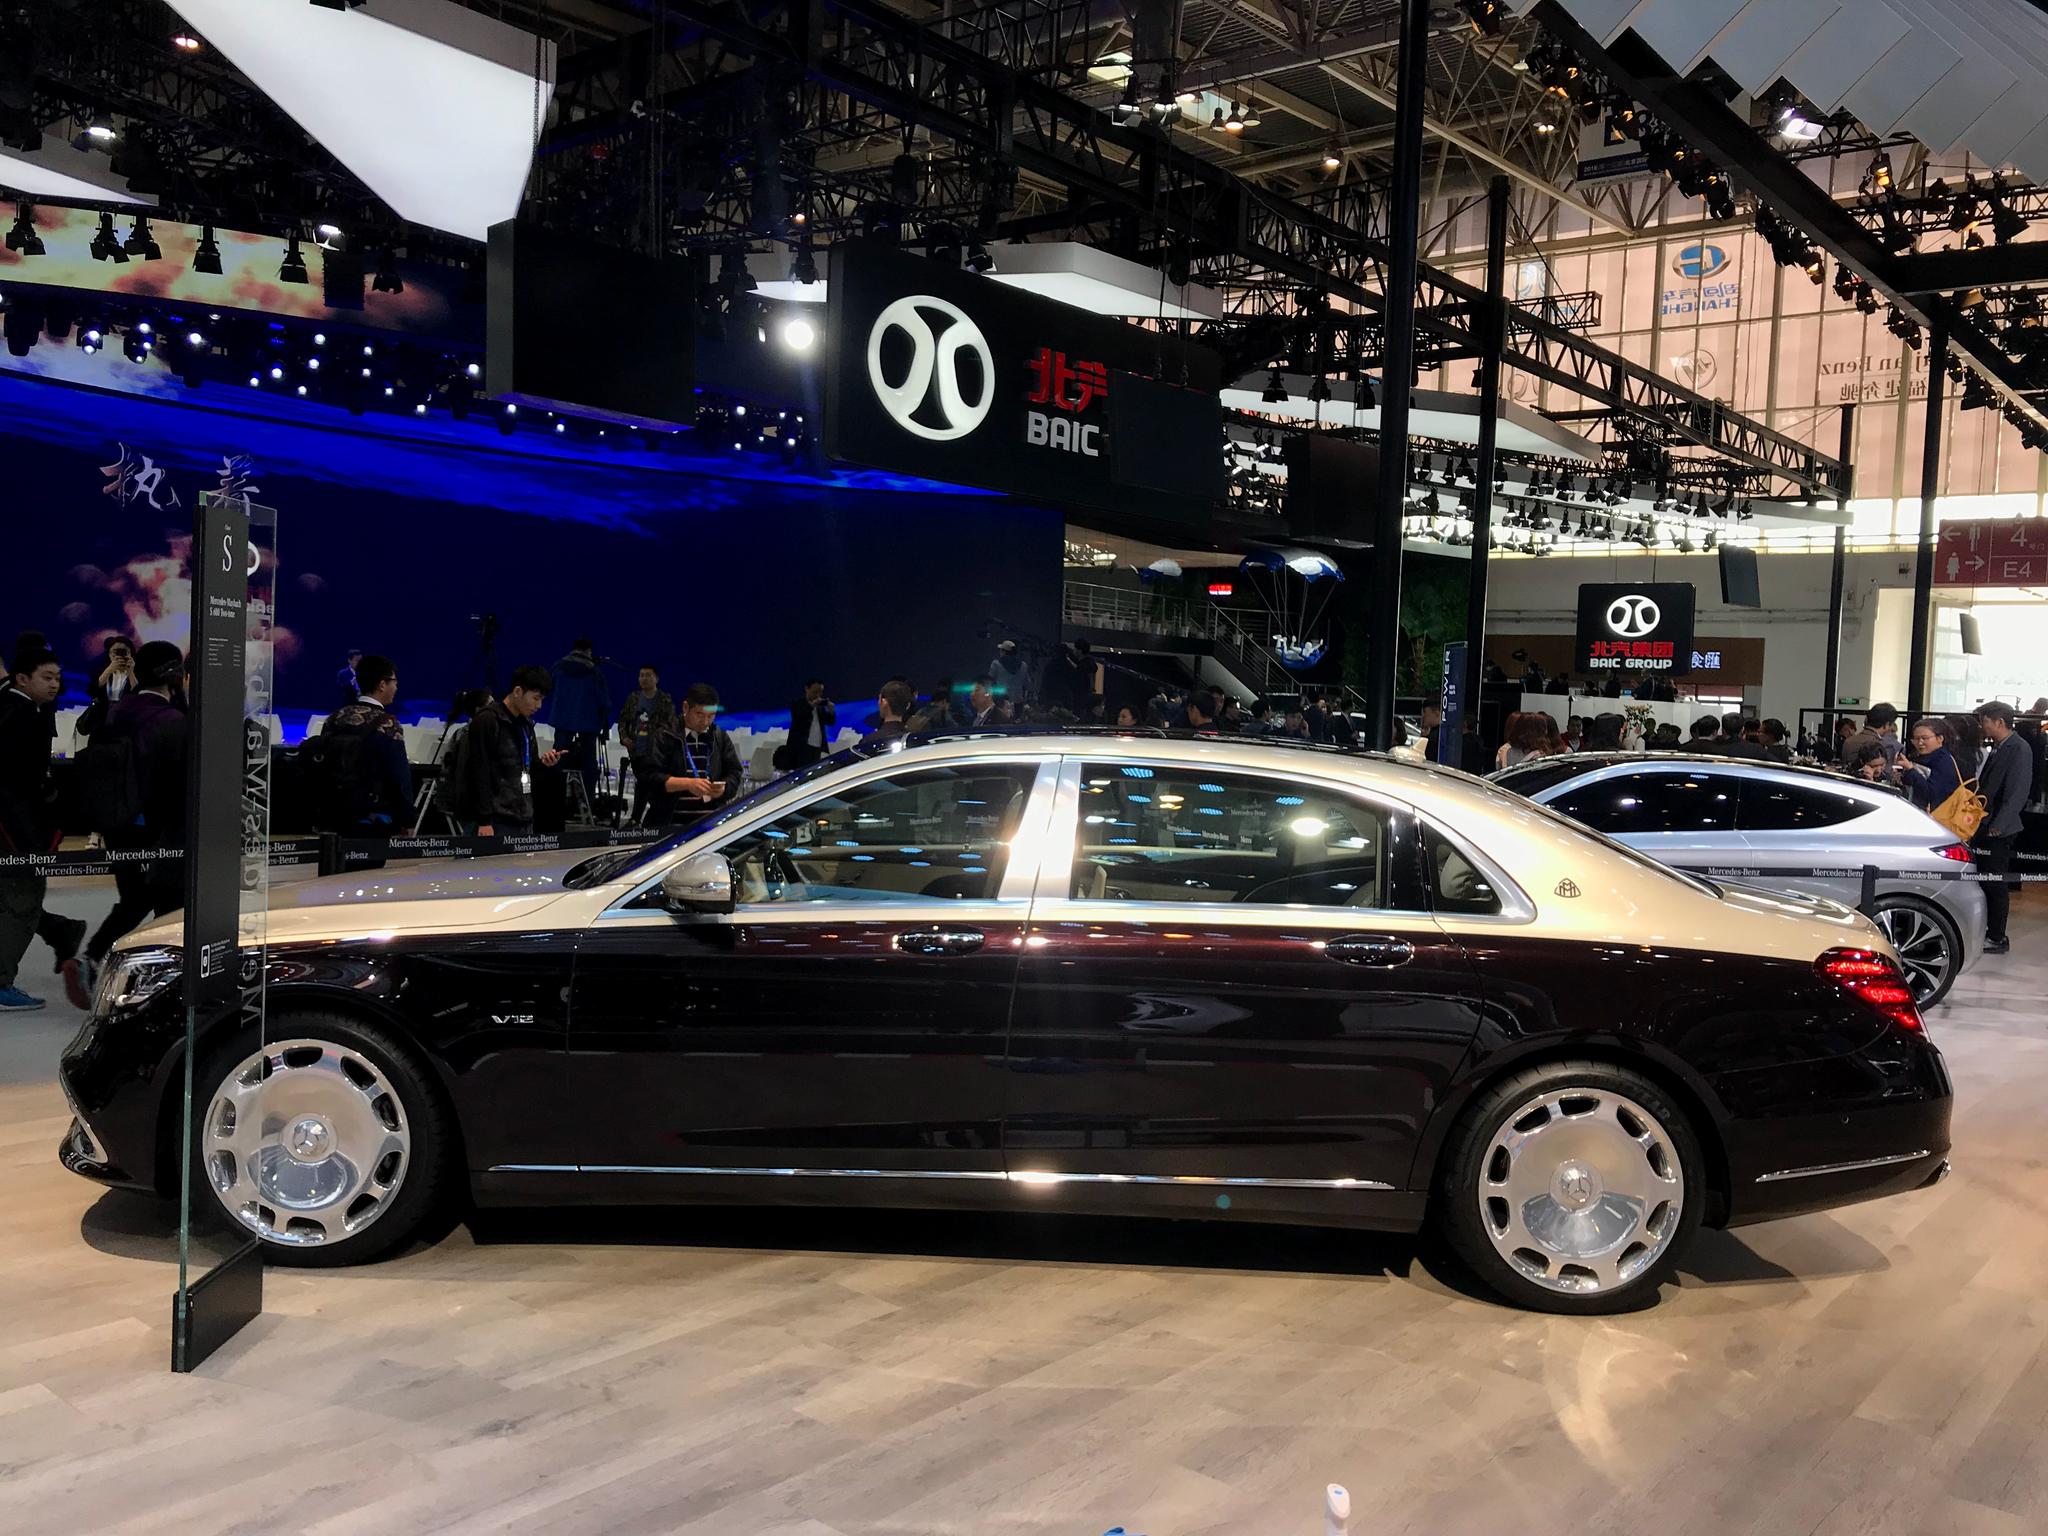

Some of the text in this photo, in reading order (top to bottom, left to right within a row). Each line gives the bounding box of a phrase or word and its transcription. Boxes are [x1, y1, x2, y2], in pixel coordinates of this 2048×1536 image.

[1027, 410, 1100, 457] BAIC
[2010, 524, 2028, 547] 4
[222, 534, 232, 572] S
[2003, 561, 2032, 578] E4
[1590, 641, 1674, 657] 北汽集团
[1589, 658, 1673, 669] BAIC GROUP
[1441, 650, 1451, 722] POWER
[610, 828, 660, 838] Mercedes-Benz
[389, 838, 449, 848] Mercedes-Benz
[503, 834, 558, 845] Mercedes-Benz
[422, 846, 472, 857] Mercedes-Benz
[514, 842, 560, 852] Mercedes-Benz
[105, 848, 184, 862] Mercedes-Benz
[35, 864, 109, 877] Mercedes-Benz
[1708, 867, 1760, 876] Mercedes-Benz
[1813, 868, 1864, 878] Mercedes-Benz
[1900, 871, 1942, 880] Mercedes-Benz
[1961, 872, 2003, 881] Mercedes-Benz
